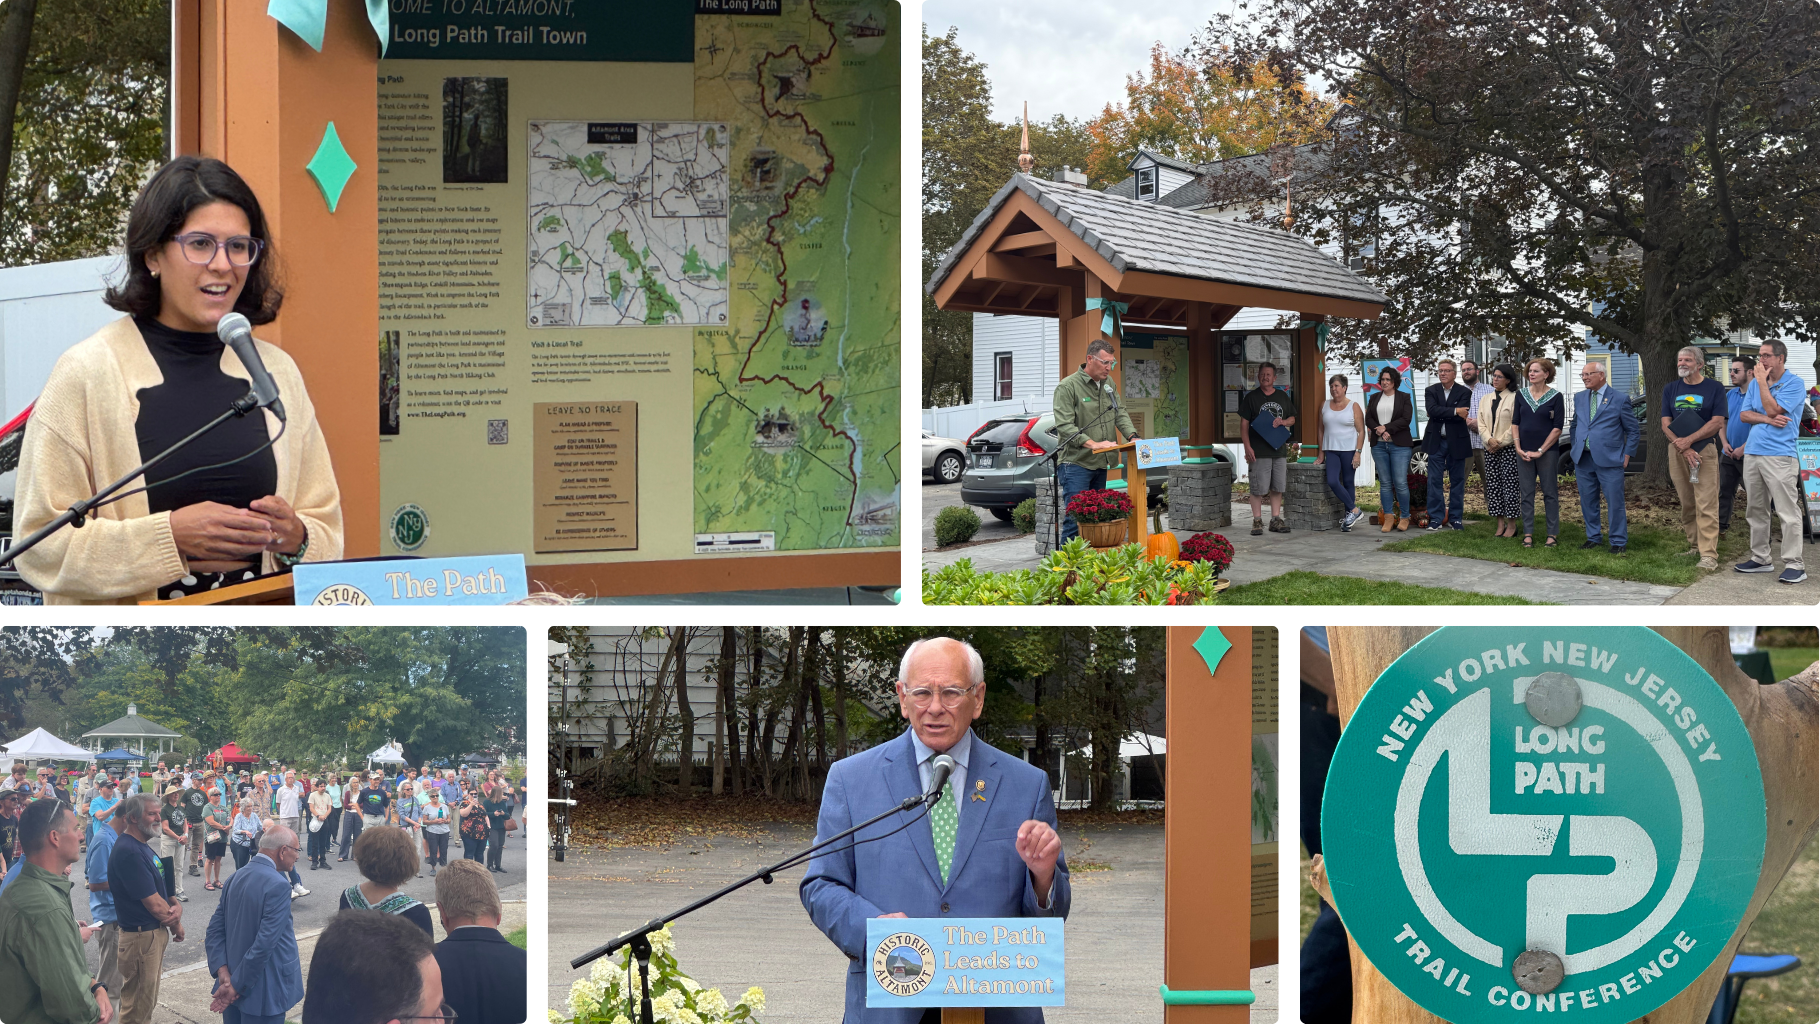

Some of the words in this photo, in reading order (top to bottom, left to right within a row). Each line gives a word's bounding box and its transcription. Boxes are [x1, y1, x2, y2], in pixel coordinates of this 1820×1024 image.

[390, 0, 433, 13] OME
[443, 0, 466, 14] TO
[471, 0, 575, 18] ALTAMONT,
[722, 0, 748, 12] Long
[752, 0, 777, 10] Path
[394, 24, 440, 47] Long
[446, 25, 488, 43] Path
[494, 26, 533, 44] Trail
[538, 26, 587, 44] Town
[548, 406, 574, 415] LEAVE
[385, 571, 438, 599] The
[442, 567, 508, 596] Path
[318, 588, 366, 606] ISTORI
[1376, 692, 1434, 762] NEW
[1434, 641, 1531, 694] YORK
[1542, 640, 1618, 672] NEW
[1624, 666, 1722, 766] JERSEY
[1514, 725, 1606, 754] LONG
[1514, 762, 1605, 794] PATH
[878, 935, 930, 956] HISTORIC
[942, 925, 987, 945] The
[992, 925, 1046, 945] Path
[942, 950, 1010, 970] Leads
[1015, 952, 1039, 970] to
[1394, 923, 1472, 997] TRAIL
[1487, 930, 1698, 1012] CONFERENCE
[876, 969, 932, 994] ALTAMONT
[942, 975, 1055, 995] Altamont
